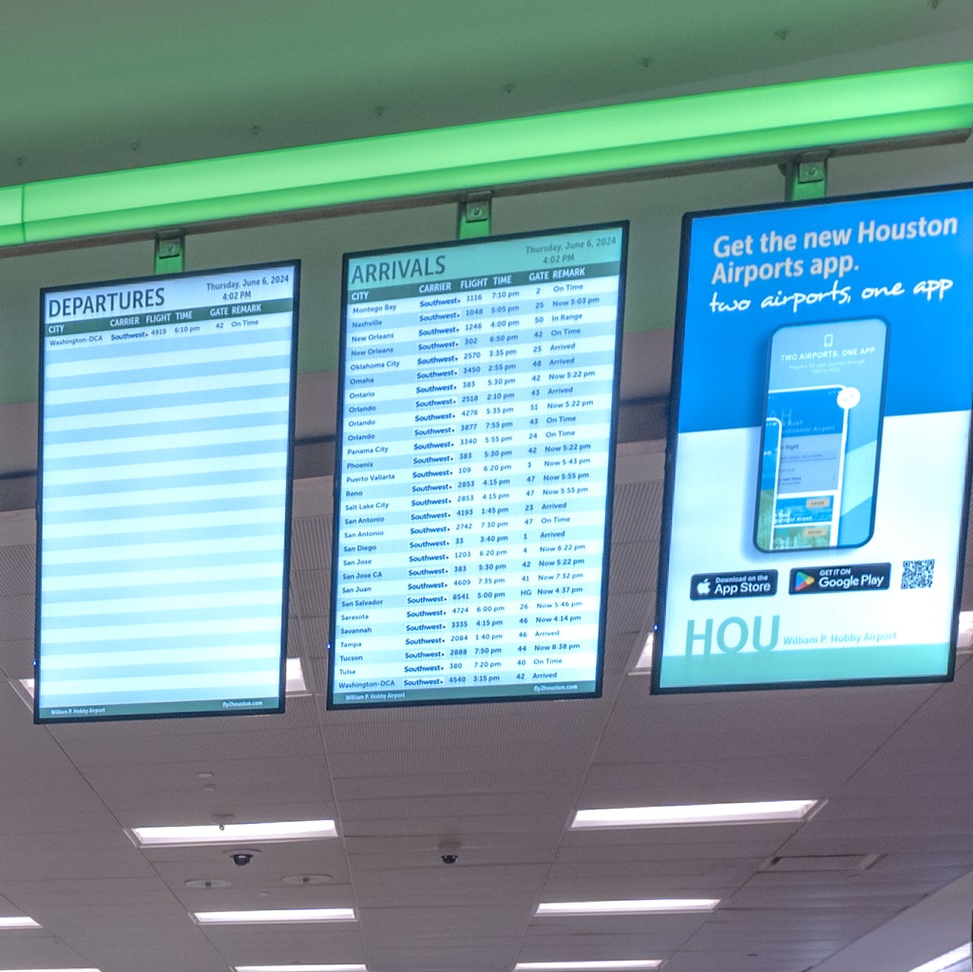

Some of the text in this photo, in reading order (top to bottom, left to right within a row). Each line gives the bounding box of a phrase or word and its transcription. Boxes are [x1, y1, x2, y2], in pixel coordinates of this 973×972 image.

[526, 237, 616, 255] Thursday, June 6, 2024
[713, 216, 958, 258] Get the new Houston
[352, 255, 446, 284] ARRIVALS
[543, 254, 574, 264] 4:02 PM
[711, 253, 859, 286] Airports app.
[207, 275, 289, 291] Thursday, June 6, 2024
[352, 268, 585, 301] CITY CARRIER FLIGHT TIME GATE REMARK
[49, 288, 165, 318] DEPARTURES
[223, 291, 251, 301] 4:02 PM
[353, 305, 382, 314] Montego
[385, 303, 397, 312] Bay
[420, 297, 458, 307] Southwest
[492, 291, 505, 299] 7:10
[567, 283, 583, 291] Time
[709, 292, 751, 313] two
[861, 282, 904, 300] one
[913, 279, 953, 300] app
[48, 304, 262, 334] CITY CARRIER FLIGHT TIME GATE REMARK
[352, 319, 382, 328] Nashville
[419, 312, 457, 322] Southwest
[491, 305, 505, 313] 5:05
[507, 305, 519, 313] pm
[50, 335, 103, 346] Washington-DCA
[111, 331, 145, 341] Southwest
[714, 581, 771, 595] App Store
[819, 575, 884, 589] Google Play
[685, 615, 780, 657] HOU
[784, 635, 818, 645] William
[831, 634, 861, 643] Hobby
[863, 632, 897, 642] Airport
[404, 678, 441, 687] Southwest
[533, 671, 557, 679] Arrived
